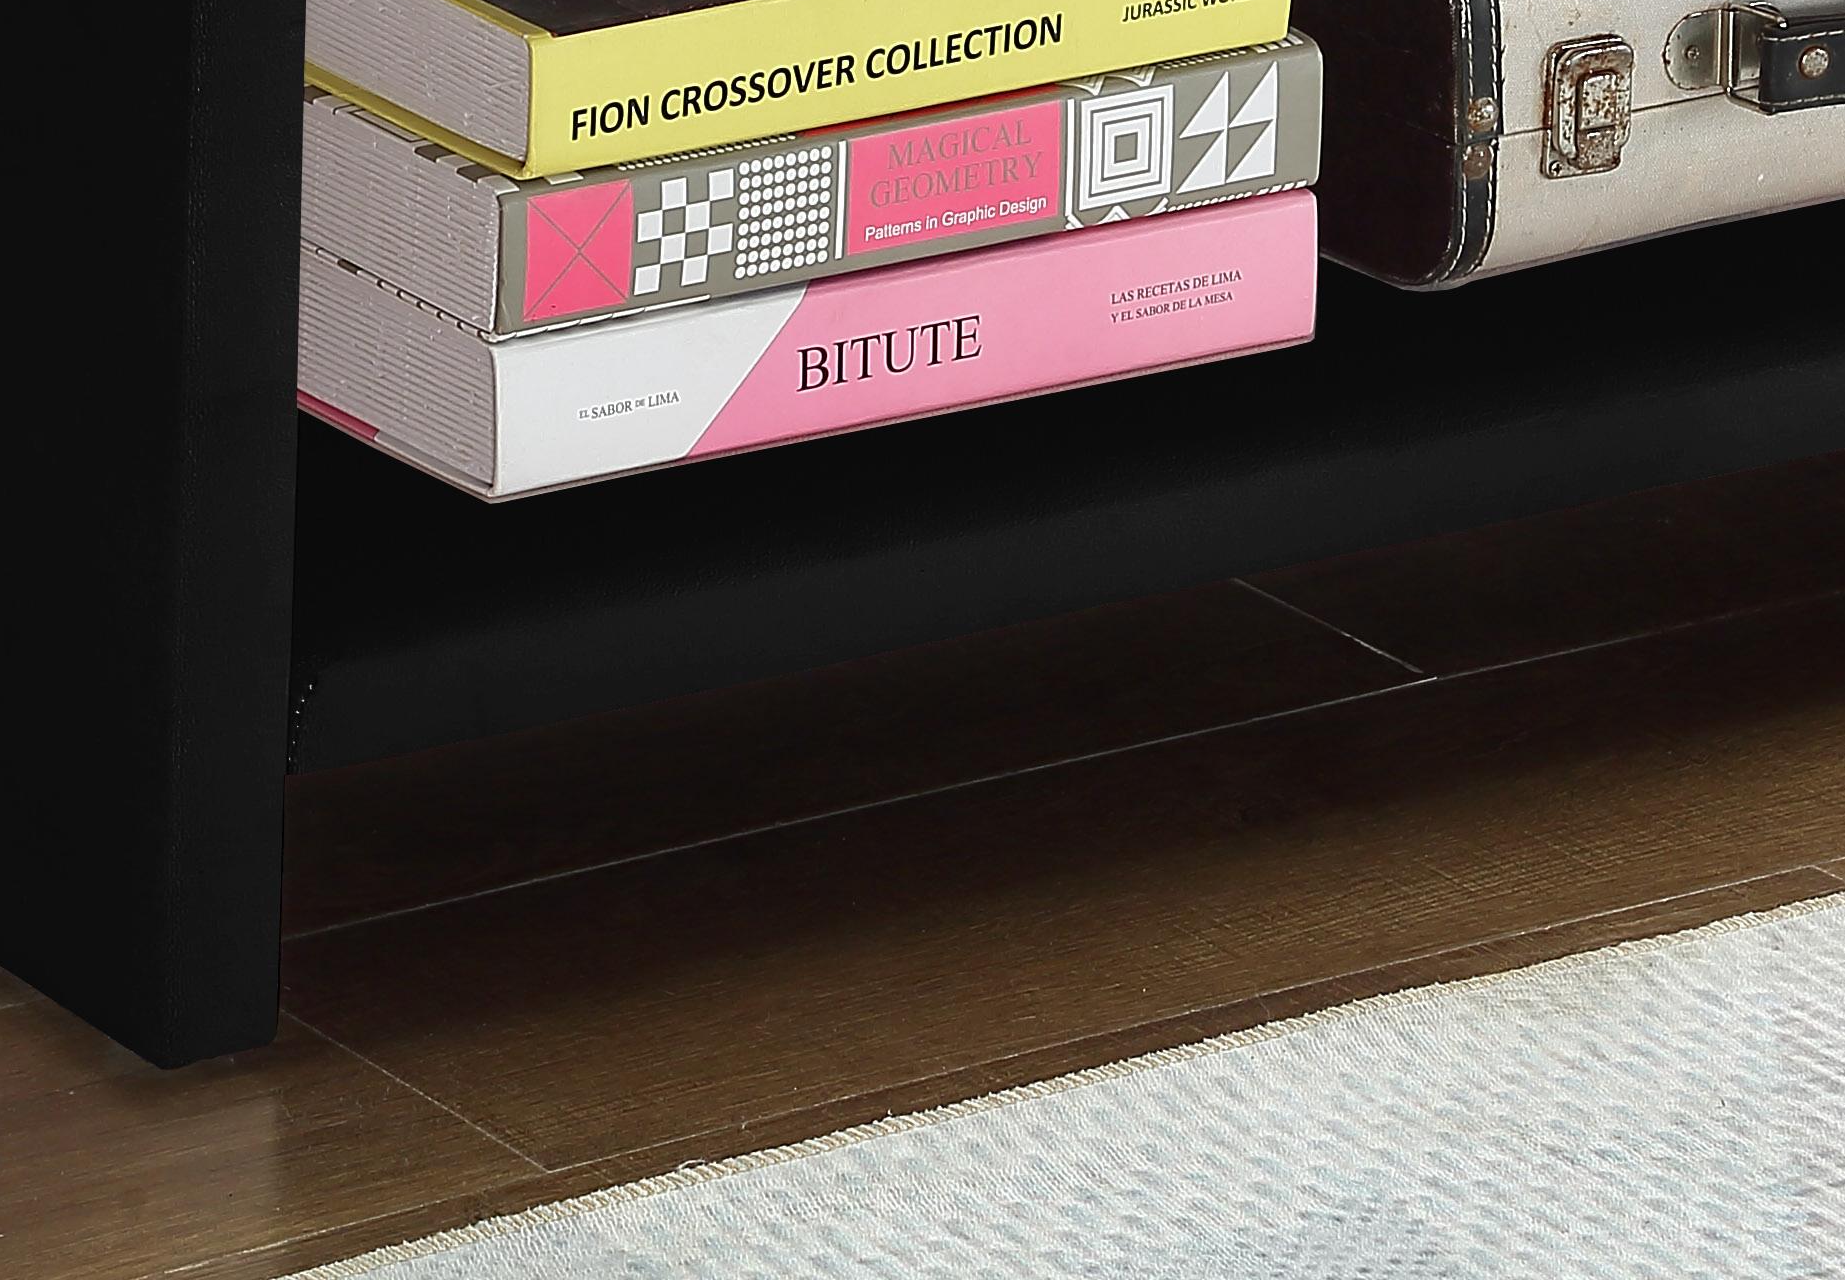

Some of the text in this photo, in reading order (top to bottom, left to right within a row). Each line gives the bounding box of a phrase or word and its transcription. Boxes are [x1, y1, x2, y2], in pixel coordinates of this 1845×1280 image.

[570, 13, 1063, 141] FION CROSSOVER COLLECTION
[887, 120, 1032, 170] MAGICAL
[870, 151, 1044, 208] GEOMETRY
[865, 196, 1047, 241] Patterns in Graphic Design
[1110, 291, 1233, 323] Y EL SABOR DE LA MESA
[1111, 270, 1242, 305] LAS RECETAS DE LIMA
[796, 315, 982, 392] BITUTE
[579, 391, 680, 420] EL SABOR DE LIMA
